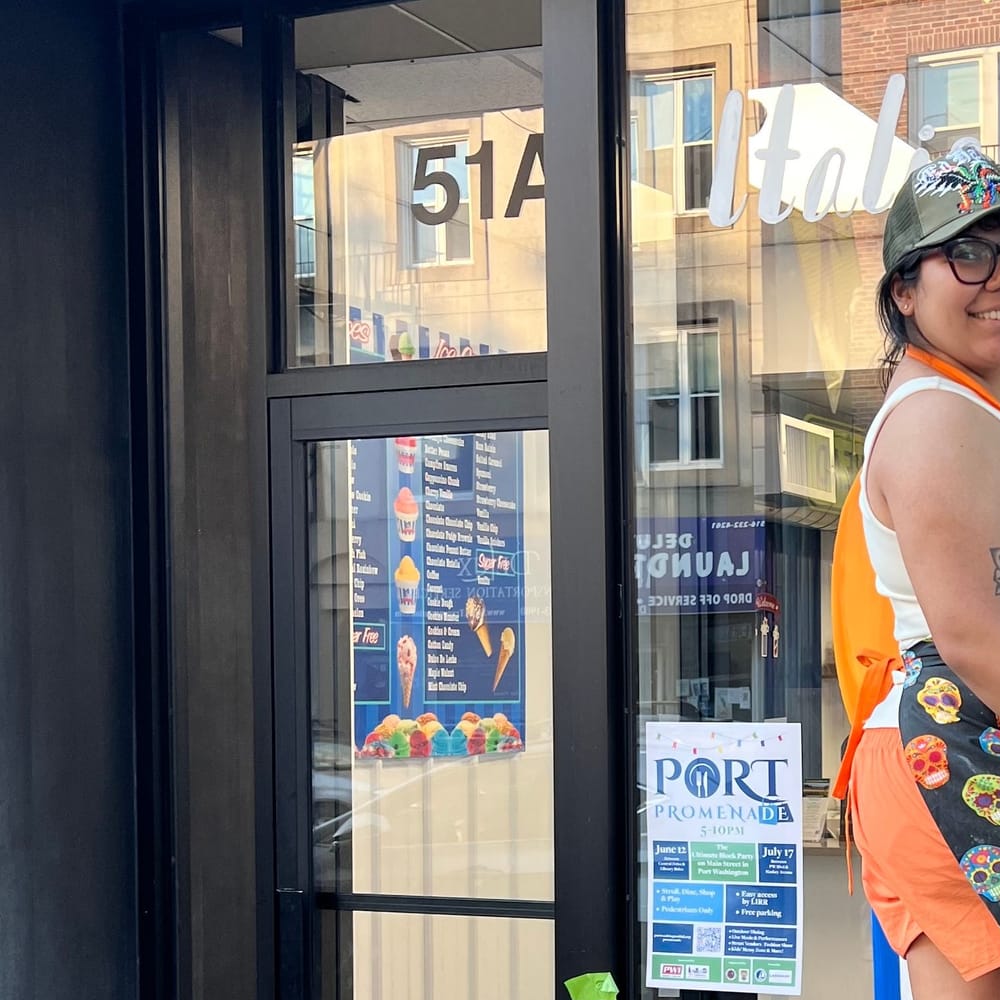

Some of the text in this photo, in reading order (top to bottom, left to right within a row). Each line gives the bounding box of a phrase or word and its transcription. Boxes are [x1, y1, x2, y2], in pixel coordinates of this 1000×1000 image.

[411, 133, 545, 226] 51A
[479, 553, 496, 570] Sugar
[497, 555, 510, 572] Free
[362, 627, 380, 644] Free
[654, 757, 789, 804] PORT
[655, 804, 794, 824] PROMENADE
[700, 826, 744, 838] 5-10PM
[656, 845, 676, 855] June
[762, 847, 794, 859] July 17
[742, 891, 756, 900] Easy
[750, 898, 768, 906] LIRR
[756, 910, 782, 918] parking
